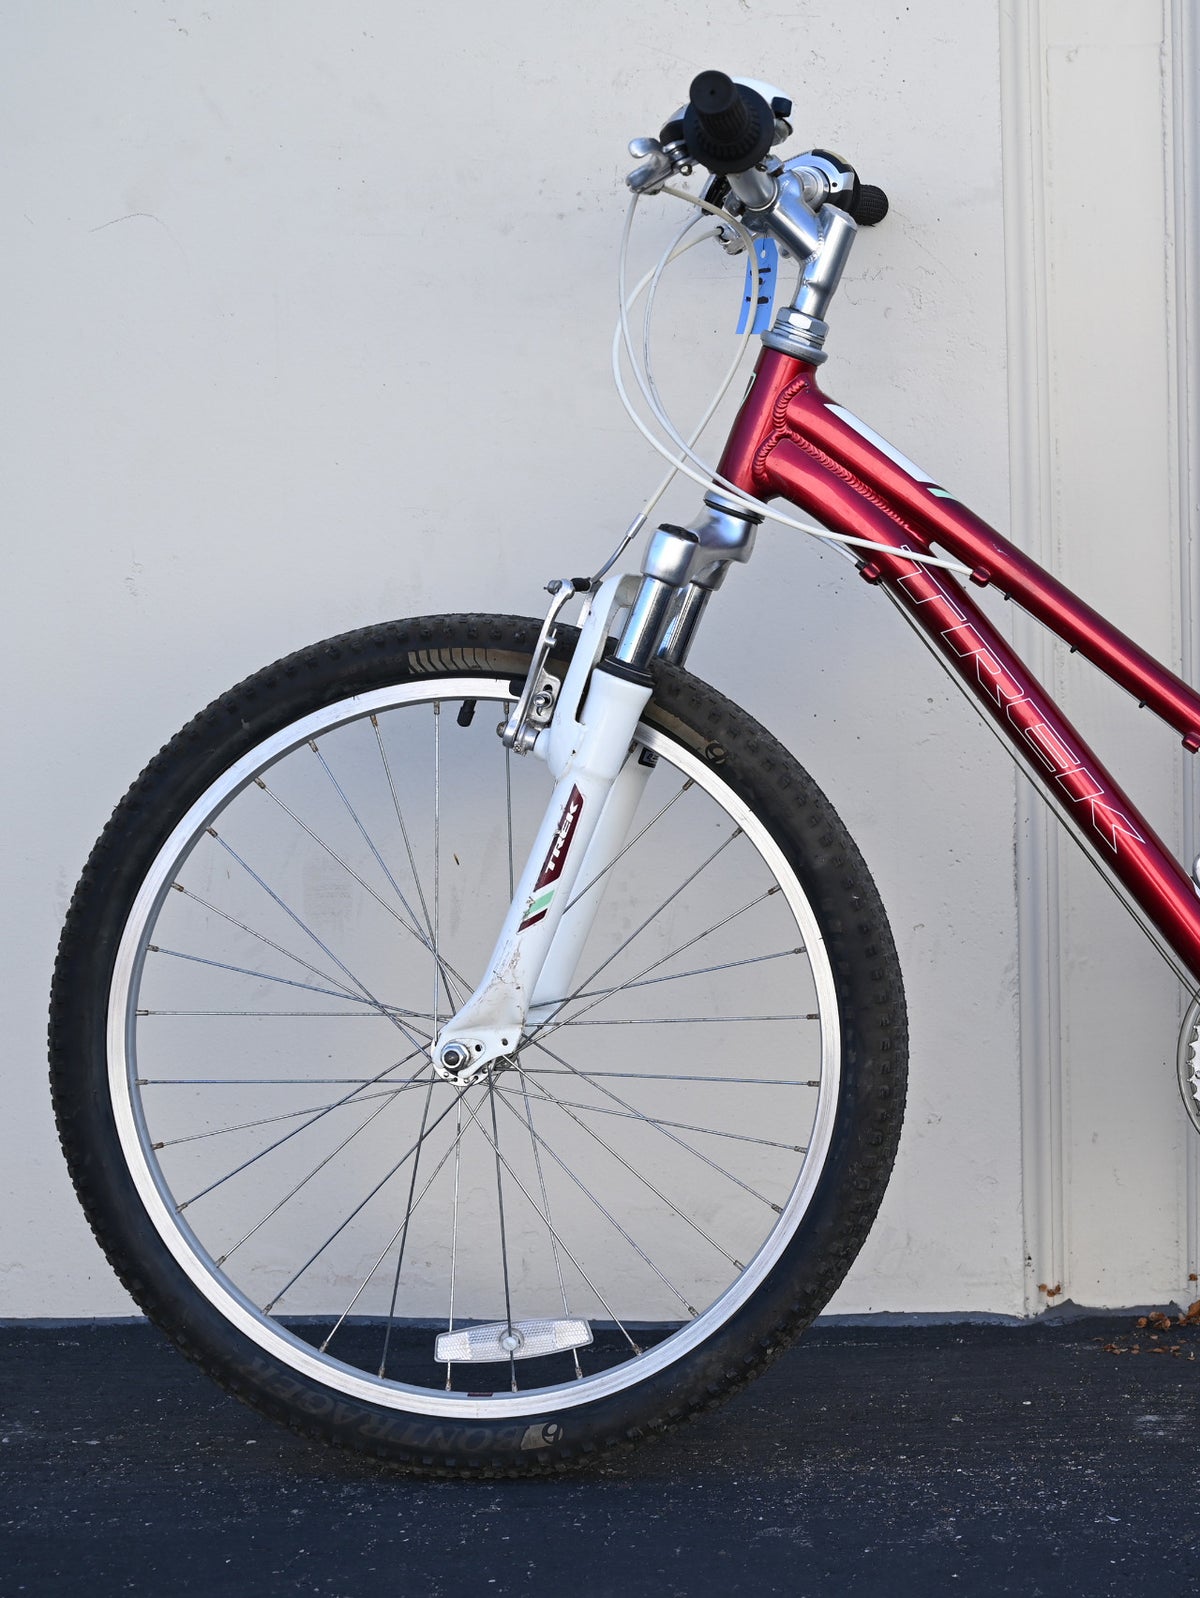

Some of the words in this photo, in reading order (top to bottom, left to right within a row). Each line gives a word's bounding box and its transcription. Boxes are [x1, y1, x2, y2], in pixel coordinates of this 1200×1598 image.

[897, 545, 1145, 854] TREK
[545, 800, 579, 874] TREK
[237, 1353, 520, 1452] BONTRAGER
